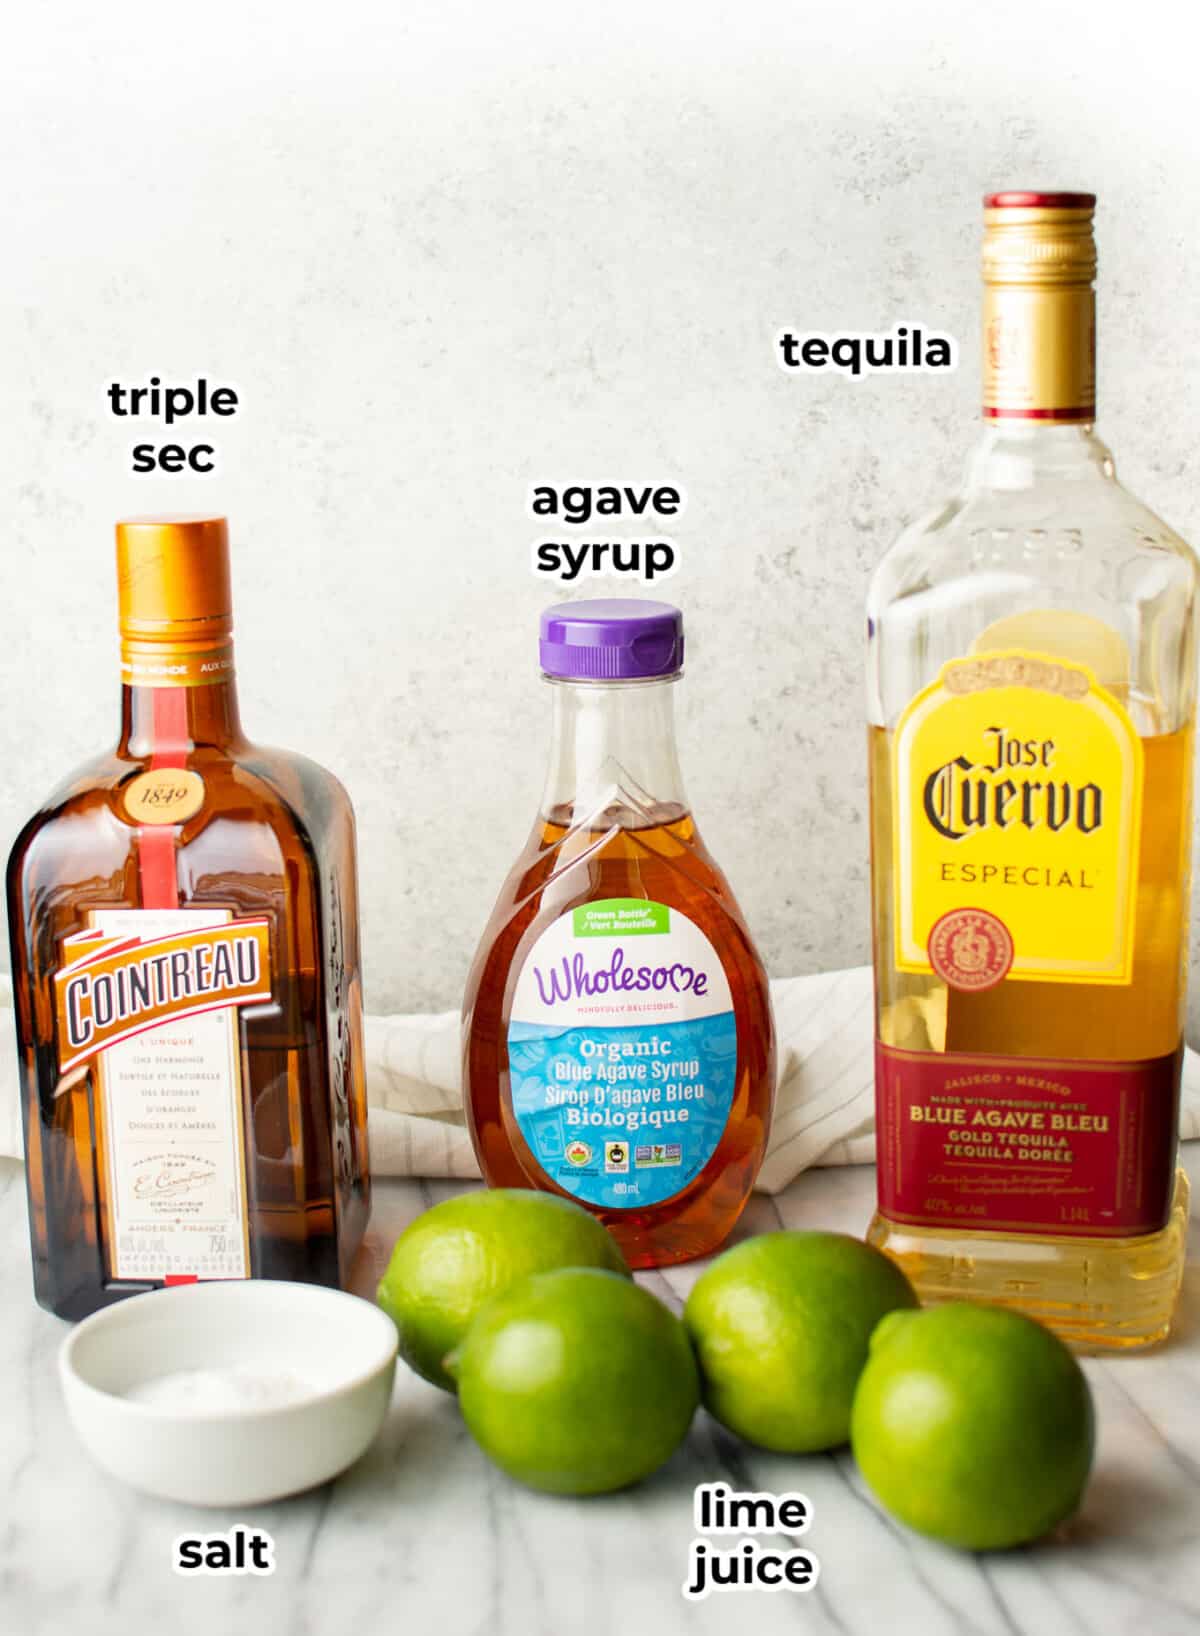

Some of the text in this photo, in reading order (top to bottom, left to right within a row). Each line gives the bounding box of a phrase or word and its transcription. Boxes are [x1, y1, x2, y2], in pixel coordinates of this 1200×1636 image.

[984, 727, 1055, 773] Jose
[141, 787, 188, 804] 1849
[923, 756, 1103, 841] Cuervo
[941, 862, 1094, 889] ESPECIAL
[533, 948, 709, 1006] Wholesome
[68, 939, 258, 1046] COINTREAU
[580, 1037, 672, 1061] Organic
[555, 1060, 699, 1084] Blue Agave Syrup
[545, 1083, 704, 1108] Sirop D'agave Bleu
[944, 1073, 1072, 1096] JALISCO MEXICO
[566, 1108, 689, 1130] Biologique
[909, 1105, 1109, 1133] BLUE AGAVE BLEU
[948, 1129, 1068, 1148] GOLD TEQUILA
[943, 1143, 1073, 1163] TEQUILA DORÉE
